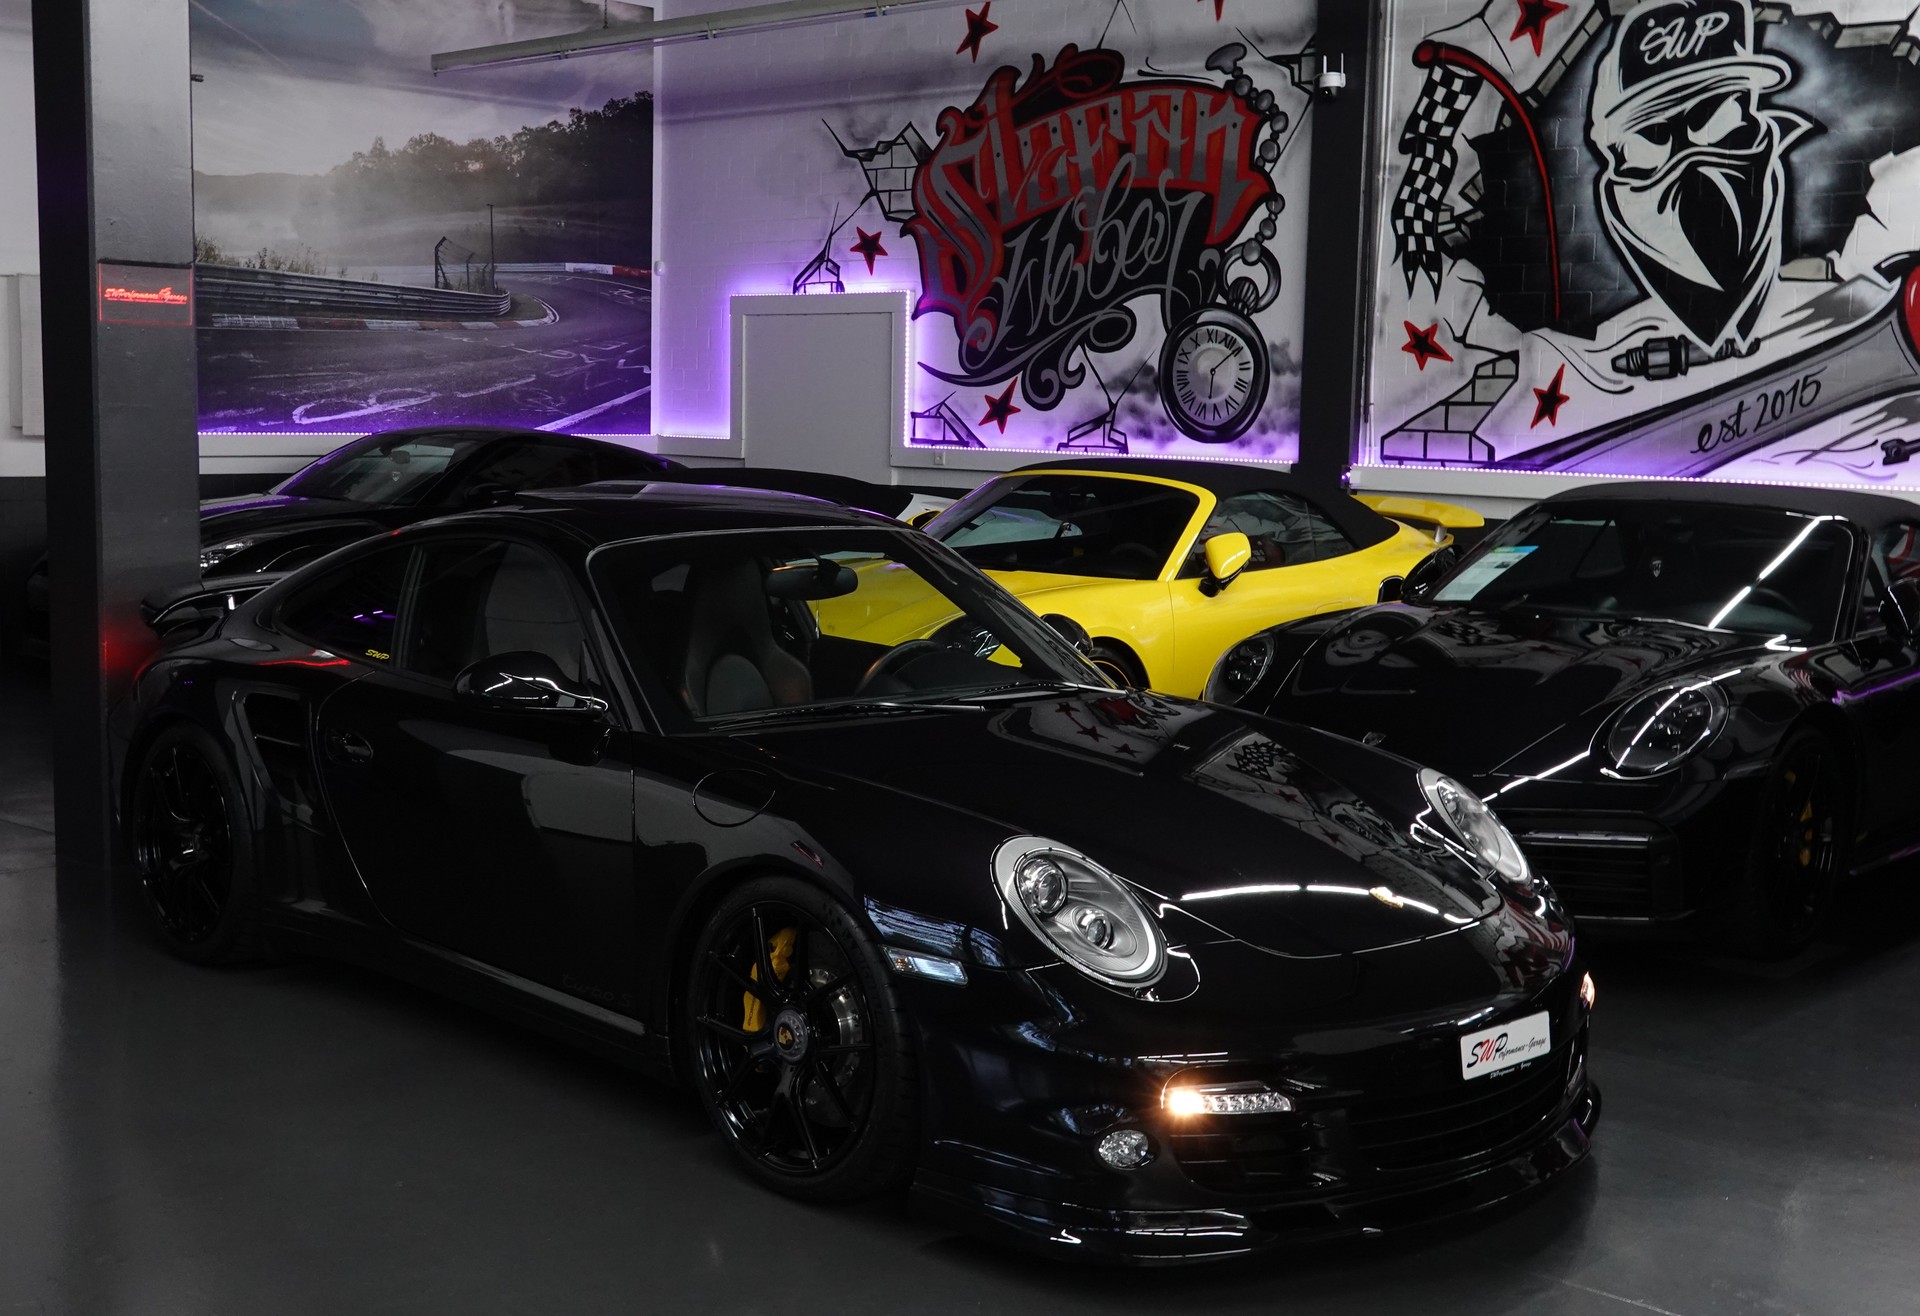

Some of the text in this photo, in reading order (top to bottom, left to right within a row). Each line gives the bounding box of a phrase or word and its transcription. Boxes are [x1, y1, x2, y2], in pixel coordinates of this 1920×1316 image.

[1640, 11, 1730, 65] SWP
[1690, 366, 1828, 454] est 2015
